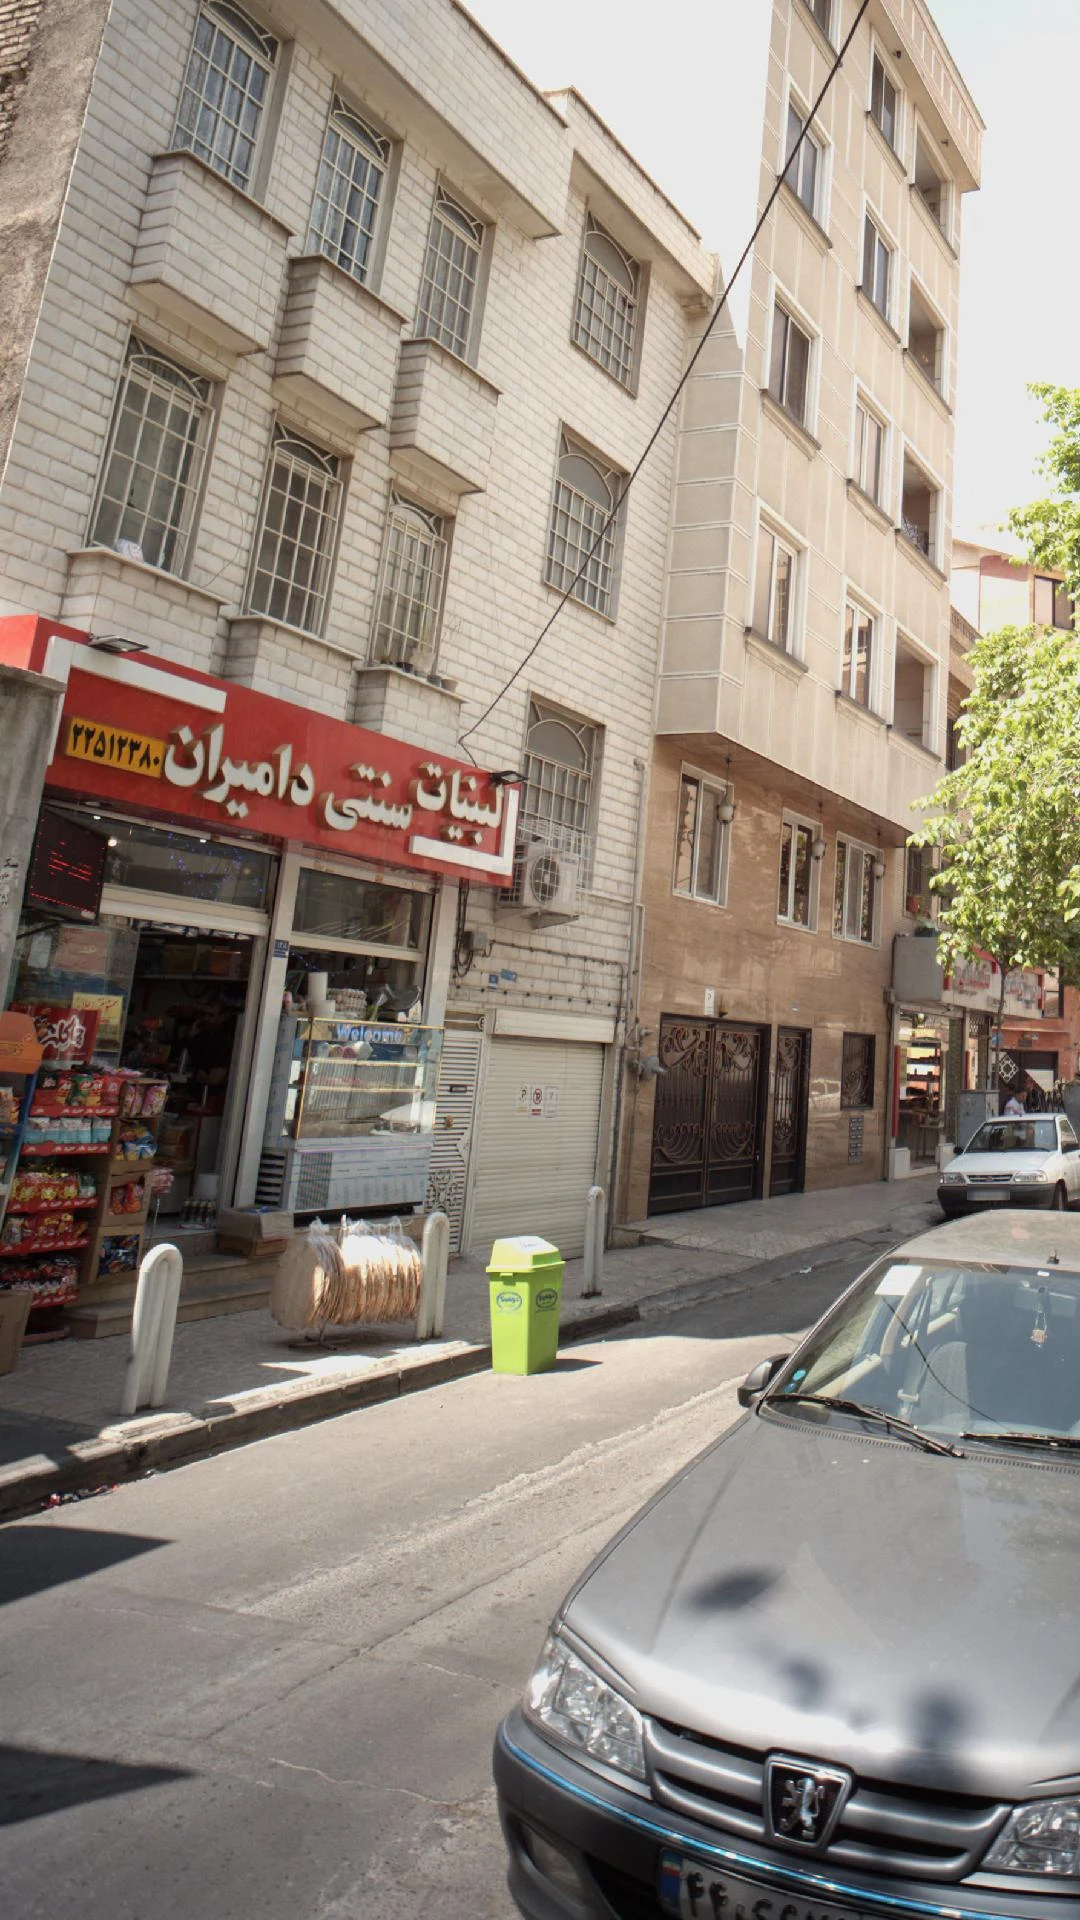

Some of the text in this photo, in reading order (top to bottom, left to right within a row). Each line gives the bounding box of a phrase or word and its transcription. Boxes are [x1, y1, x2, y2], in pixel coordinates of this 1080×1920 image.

[72, 723, 160, 769] ۲۲۵۱۲۳۸۰
[164, 724, 504, 845] لبنیات سنتی دامیران
[336, 1023, 403, 1044] Welcome
